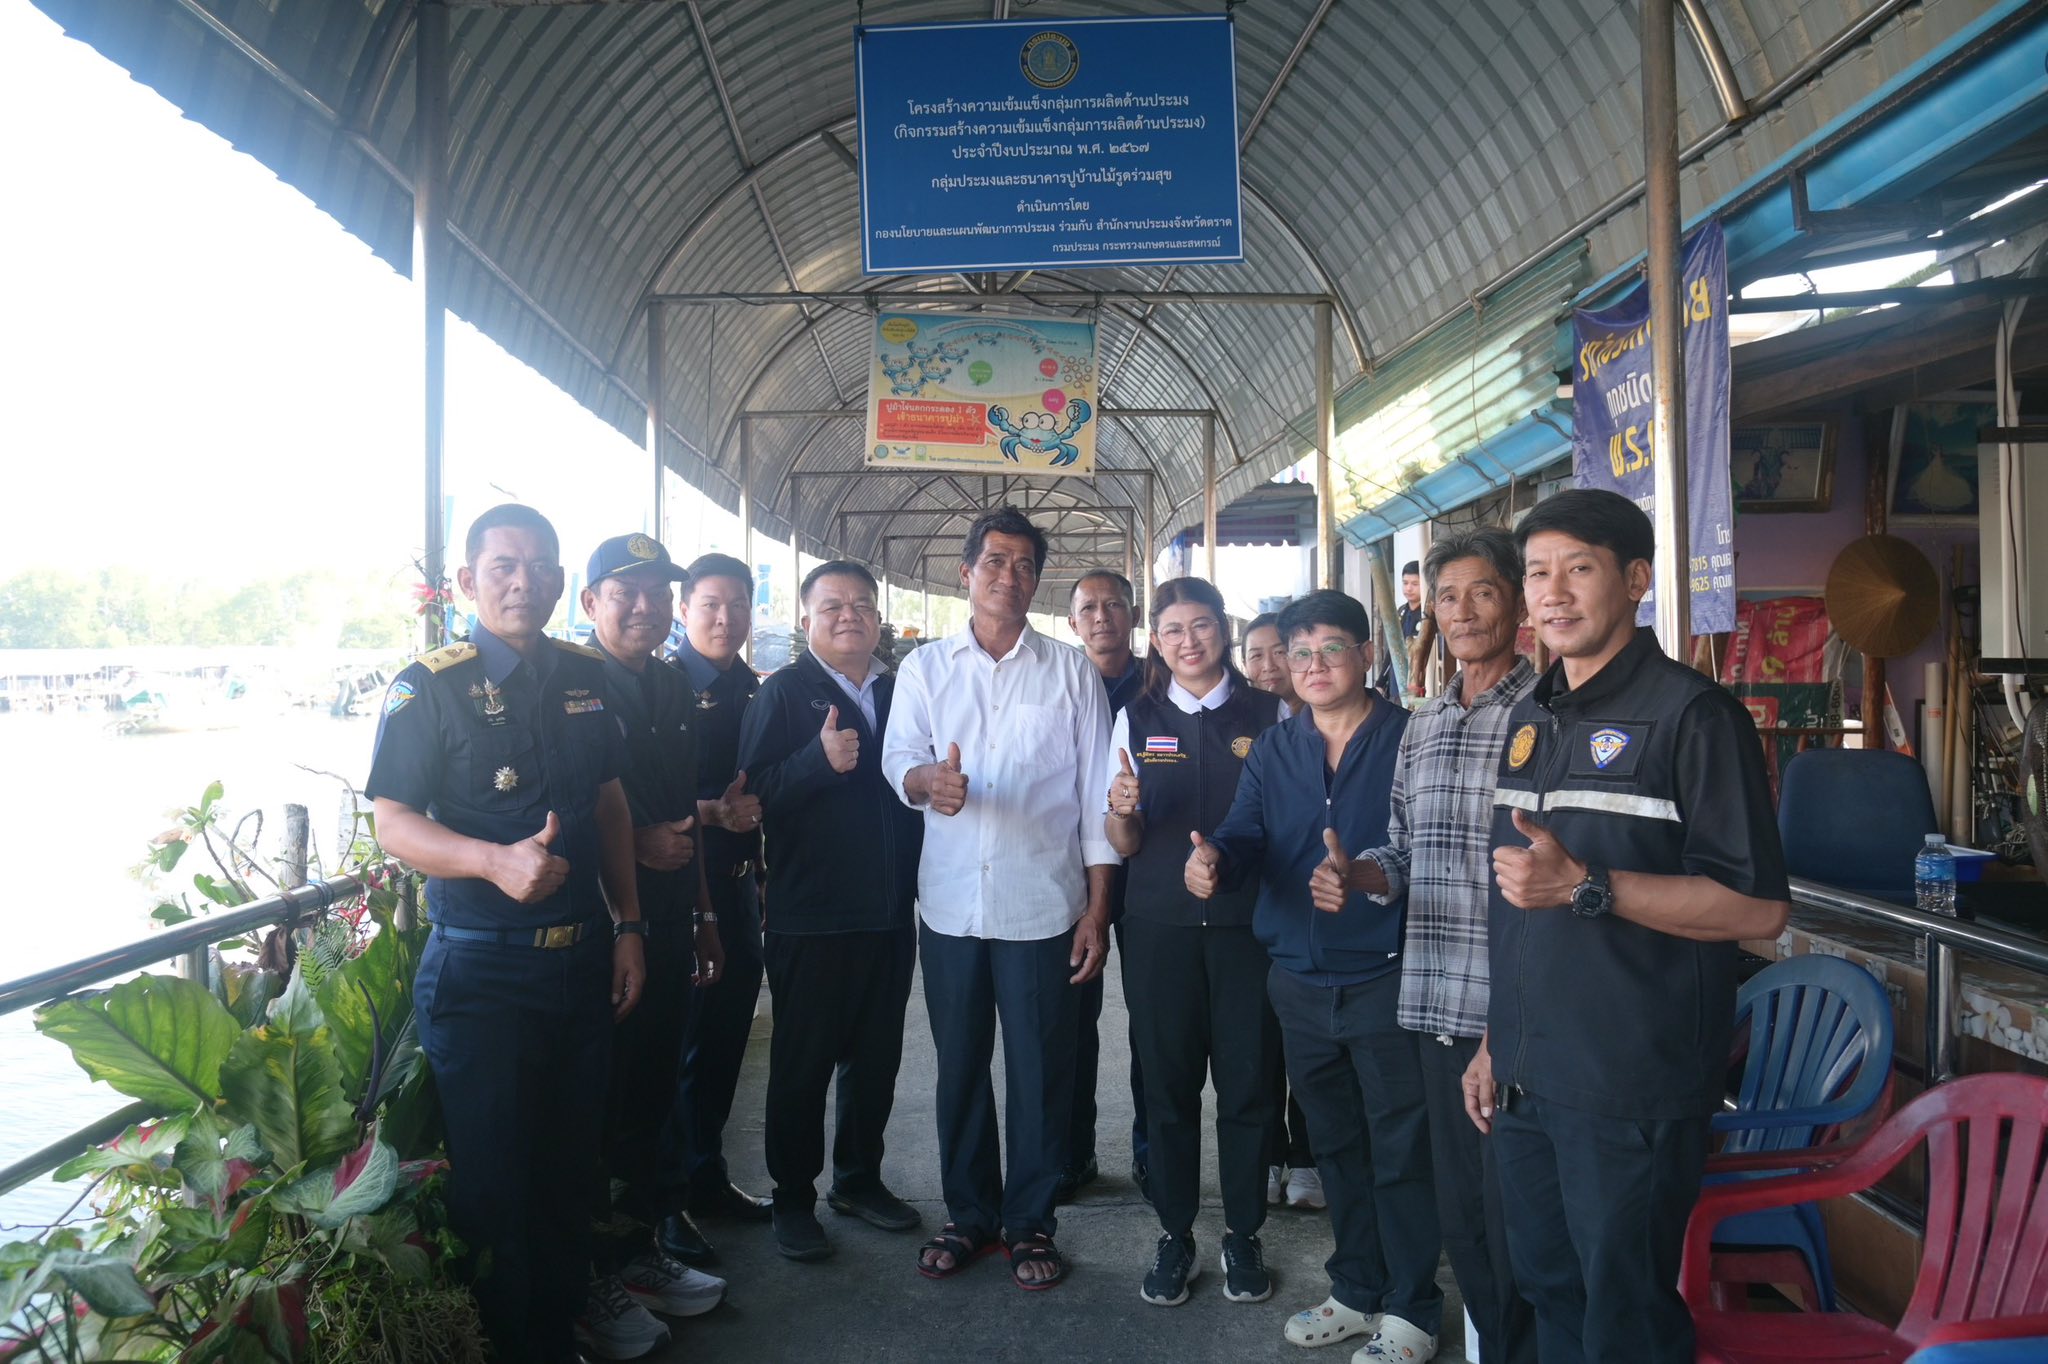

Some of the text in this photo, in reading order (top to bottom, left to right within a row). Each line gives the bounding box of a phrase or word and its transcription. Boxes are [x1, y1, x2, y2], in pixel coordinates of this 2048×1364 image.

[907, 92, 1189, 116] โครงสร้างความเข้มแข็งกลุ่มการผลิตด้านประมง
[894, 116, 1206, 139] (กิจกรรมสร้างความเข้มแข็งกลุ่มการผลิตด้านประมง)
[951, 141, 1150, 160] ประจำปีงบประมาณ พ.ศ. ๒๕๖๗
[931, 168, 1172, 193] กลุ่มประมงและธนาคารปูบ้านไม้รูดร่วมสุข
[1016, 198, 1090, 213] ดำเนินการโดย
[875, 217, 1233, 239] กองนโยบายและแผนพัฒนาการประมง ร่วมกับ สำนักงานประมงจังหวัดตราด
[1052, 236, 1221, 254] กรมประมง กระทรวงเกษตรและสหกรณ์
